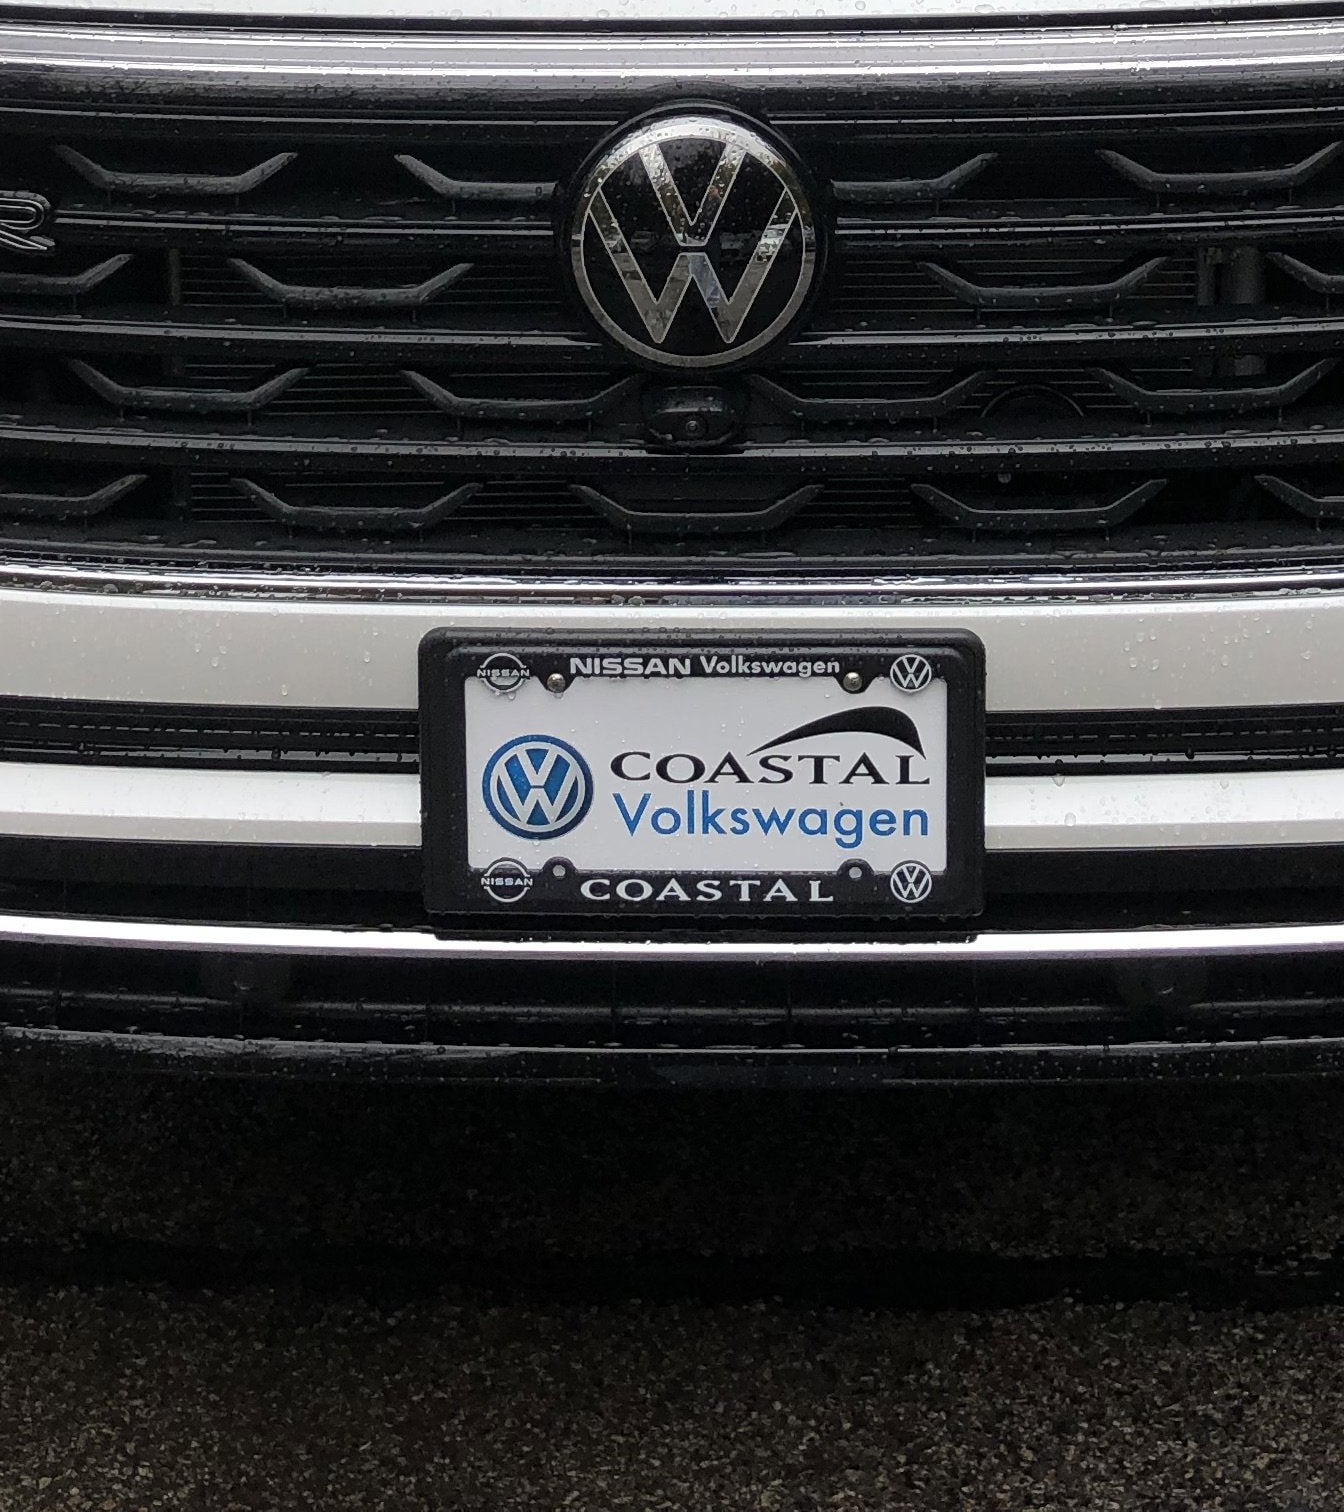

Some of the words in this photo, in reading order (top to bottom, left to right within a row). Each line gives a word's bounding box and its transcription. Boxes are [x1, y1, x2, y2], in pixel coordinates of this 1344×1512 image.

[476, 668, 530, 679] NISSAN
[570, 656, 691, 675] NISSAN
[700, 655, 840, 678] Volkswagen
[610, 750, 930, 785] COASTAL
[612, 789, 929, 849] Volkswagen
[481, 876, 534, 887] NISSAN
[581, 878, 834, 903] COASTAL
